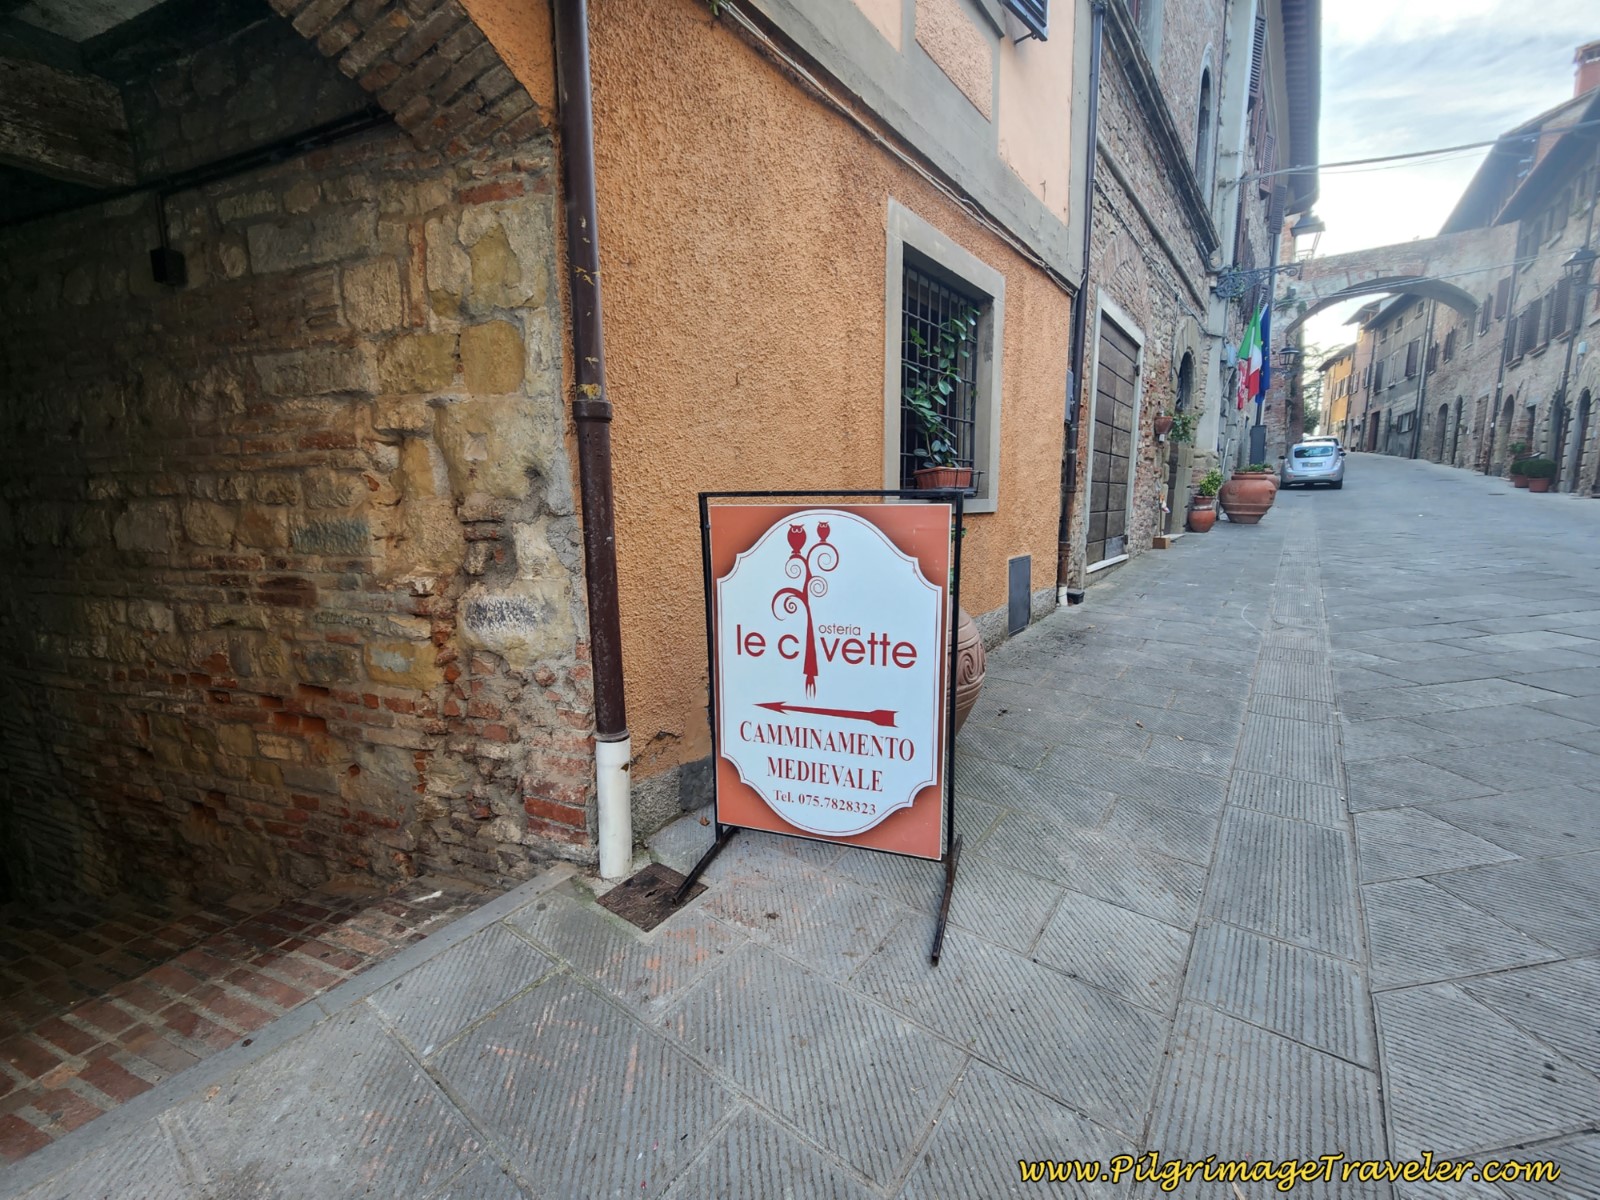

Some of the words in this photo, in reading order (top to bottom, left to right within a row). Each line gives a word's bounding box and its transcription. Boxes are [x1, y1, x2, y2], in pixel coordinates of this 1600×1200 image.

[736, 624, 766, 656] le
[818, 623, 861, 636] osteria
[740, 720, 915, 762] CAMMINAMENTO
[767, 756, 883, 792] MEDIEVALE
[773, 789, 795, 804] Tel.
[798, 793, 876, 815] 075.7828323
